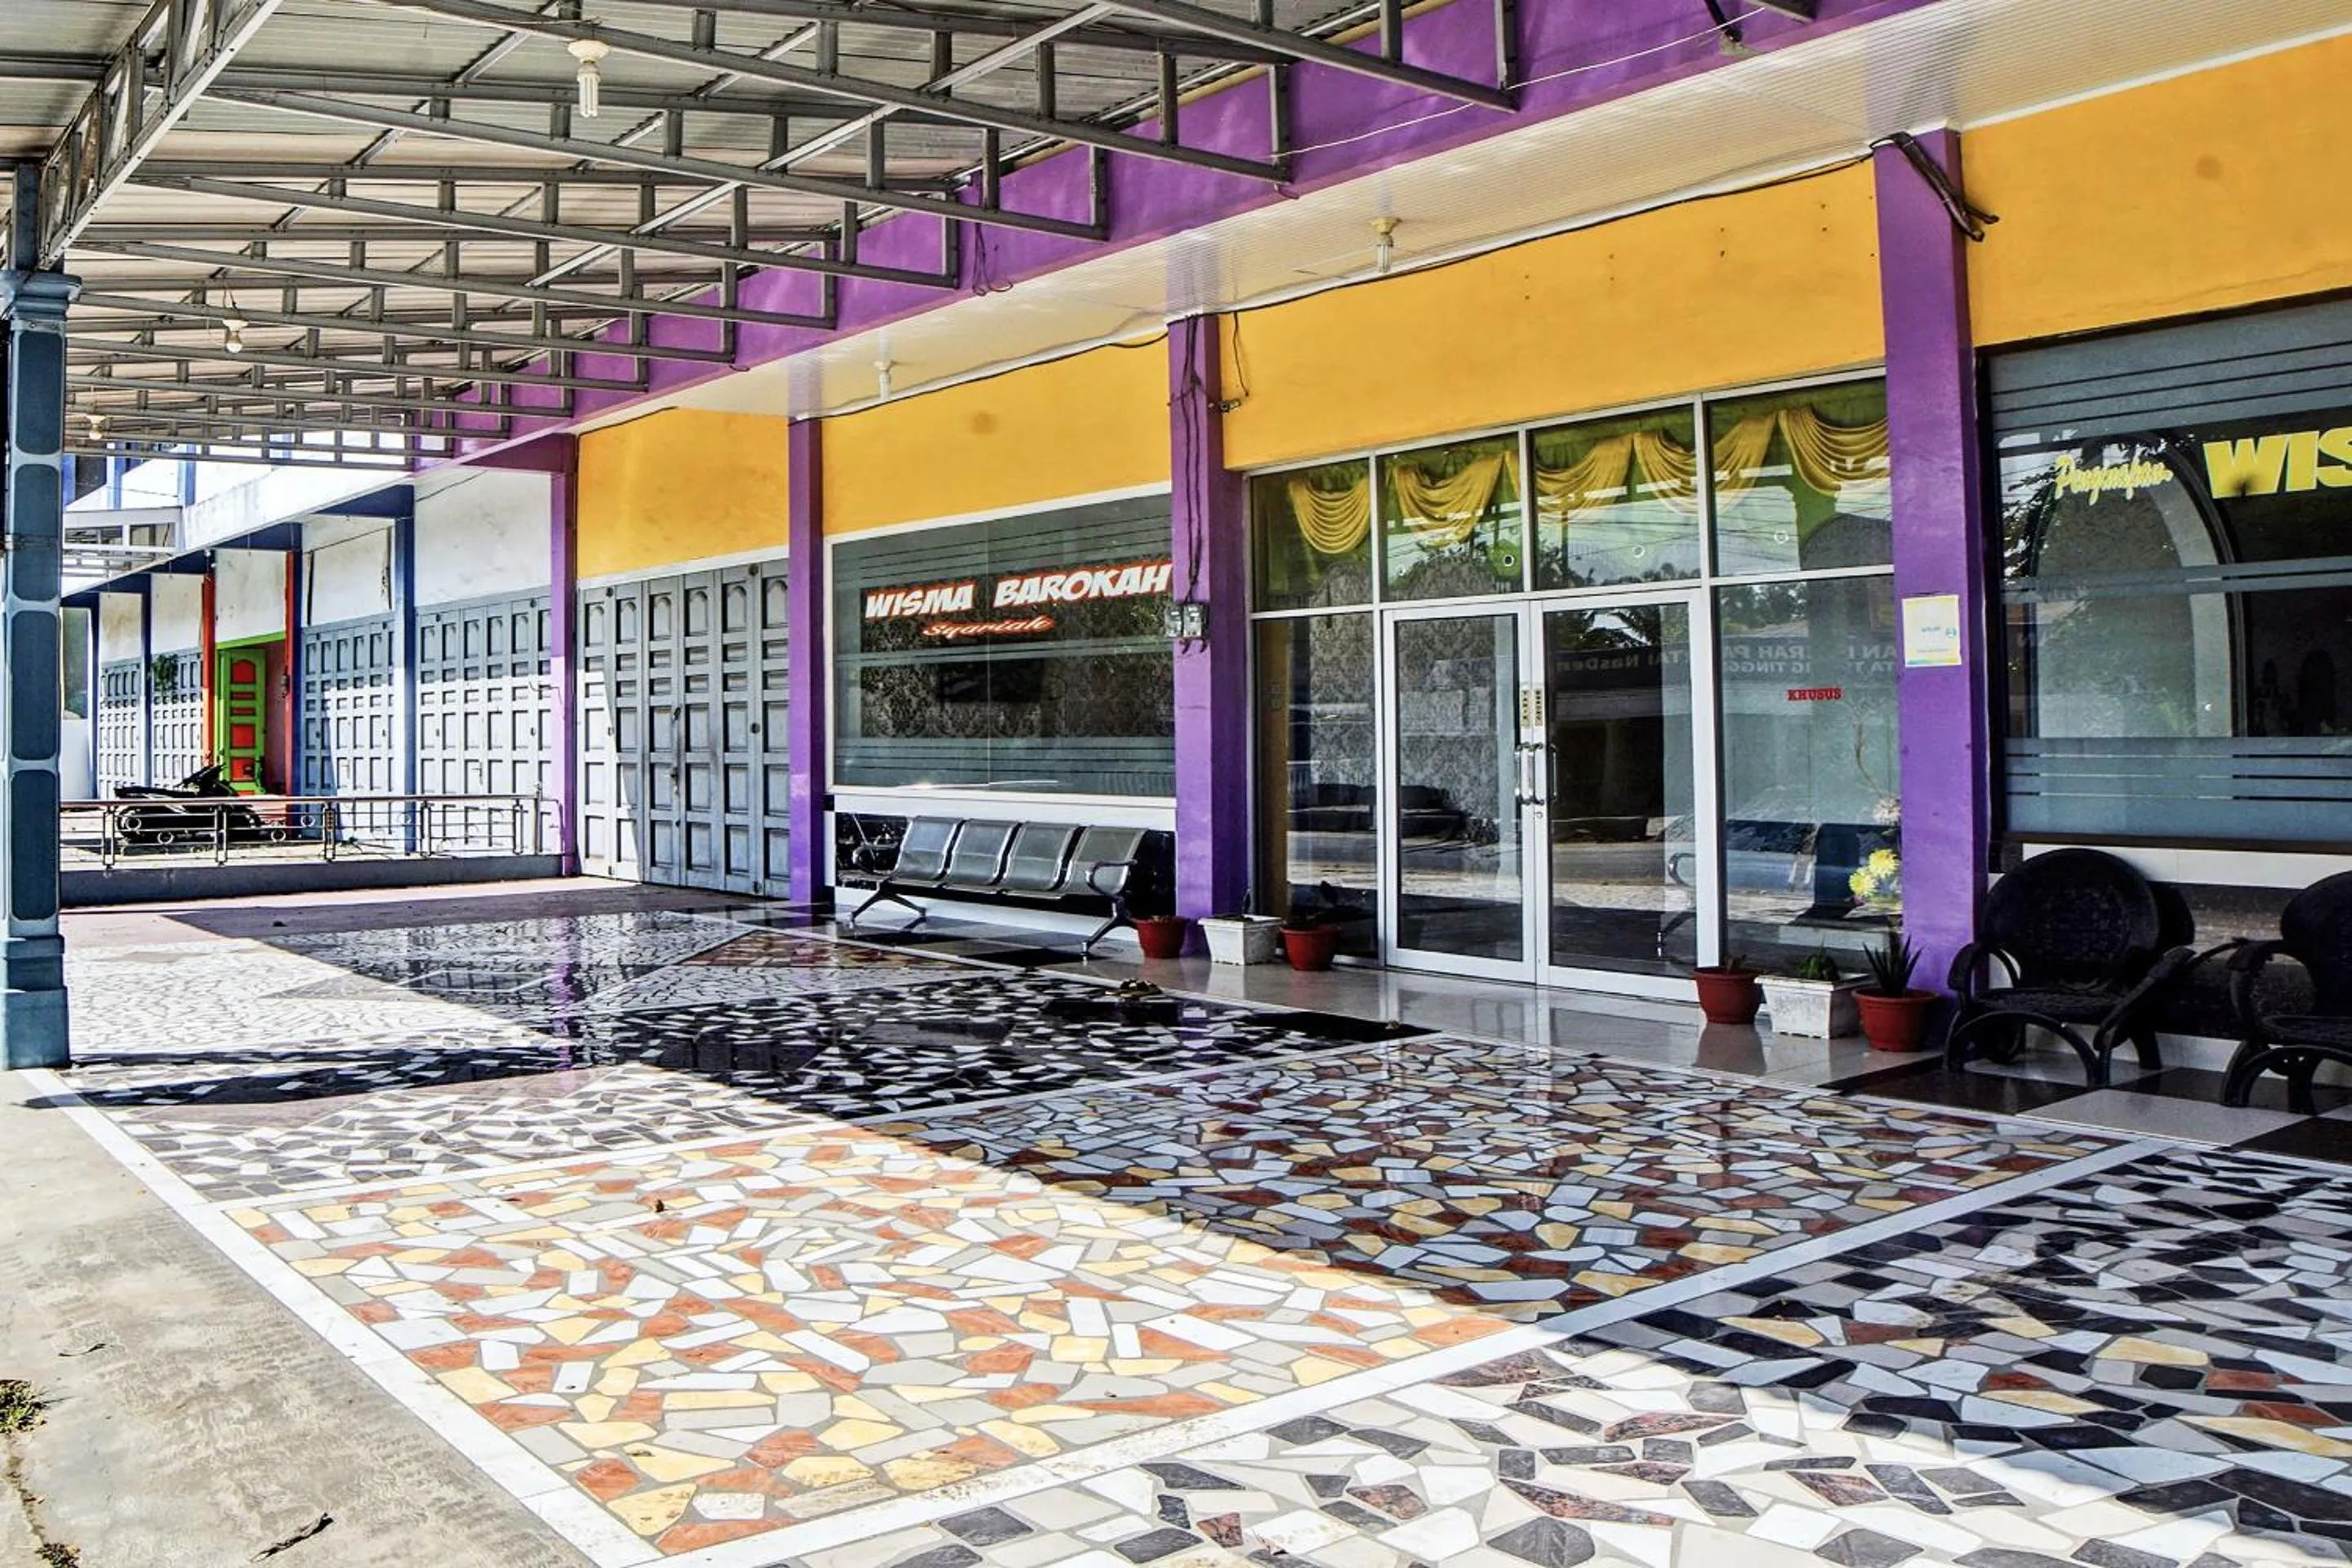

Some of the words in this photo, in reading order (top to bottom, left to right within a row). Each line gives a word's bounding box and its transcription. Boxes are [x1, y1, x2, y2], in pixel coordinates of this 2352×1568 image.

[865, 583, 974, 619] WISMA
[992, 562, 1173, 608] BAROKAH
[1788, 688, 1842, 701] KHUSUS
